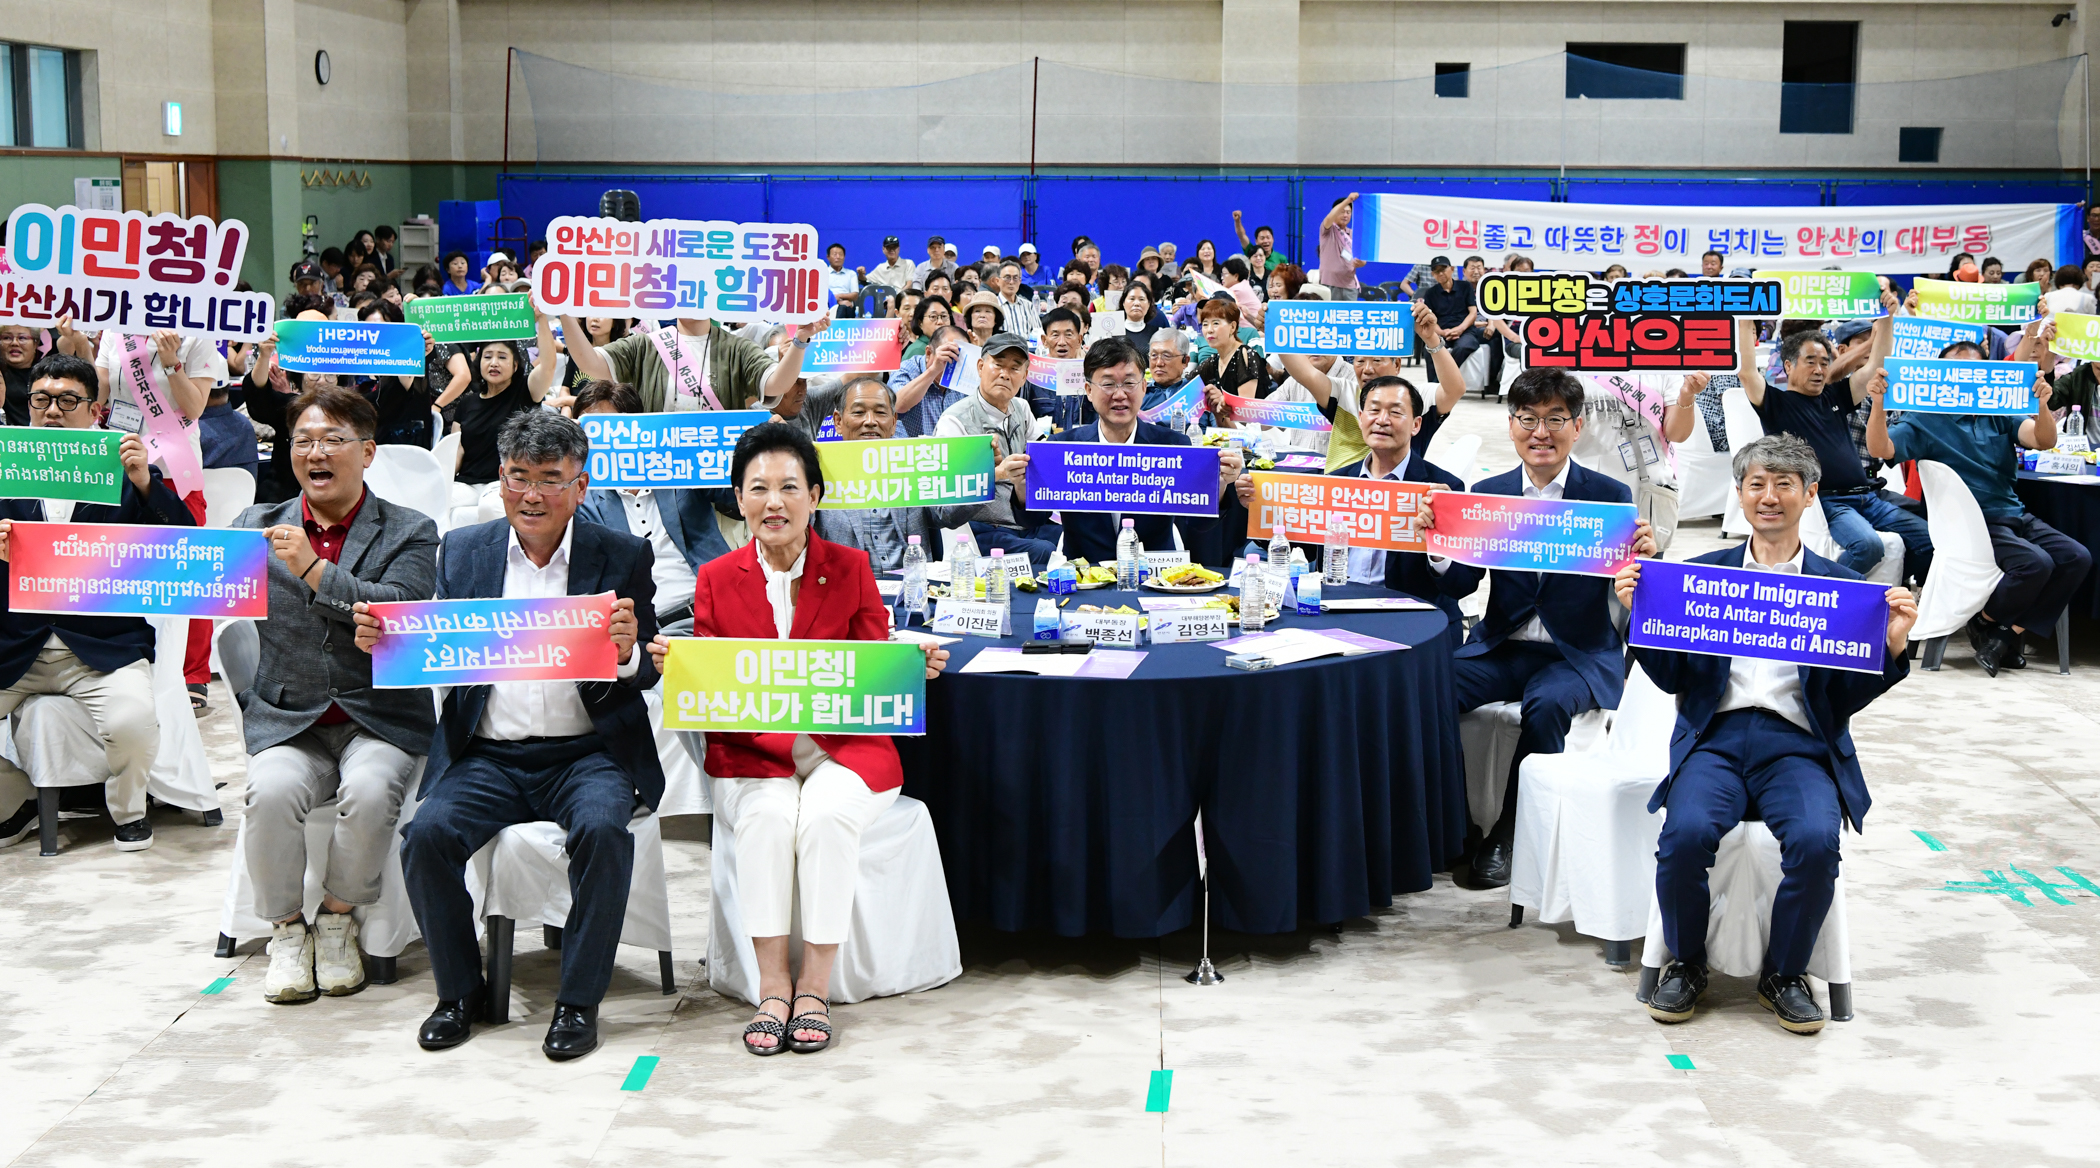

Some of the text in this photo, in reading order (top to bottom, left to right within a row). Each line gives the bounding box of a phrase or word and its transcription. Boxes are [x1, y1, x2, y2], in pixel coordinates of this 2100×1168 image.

[13, 211, 241, 286] 이민청!
[556, 225, 809, 261] 안산의 새로운 도전!
[1544, 225, 1625, 253] 따뜻한
[1634, 225, 1688, 255] 정이
[1708, 227, 1786, 256] 넘치는
[1797, 226, 1885, 257] 안산의
[1895, 224, 1991, 255] 대부동
[541, 260, 820, 315] 이민청과 함께!
[1485, 278, 1778, 313] 이민청은 상호문화도시
[1788, 275, 1850, 296] 이민청!
[1950, 285, 2008, 302] 이민청!
[0, 281, 267, 335] 안산시가 합니다!
[1279, 308, 1399, 325] 안산의 새로운 도전!
[1827, 298, 1881, 316] 합니다!
[1921, 302, 2036, 321] 안산시가 합니다!
[318, 327, 380, 345] Ансан!
[1274, 325, 1404, 350] 이민청과 함께!
[1527, 316, 1734, 369] 안산으로
[1893, 322, 1921, 338] 안산의
[1921, 325, 1952, 341] 새로운
[306, 344, 391, 357] Этим займётся город
[658, 331, 684, 361] 대부동
[2055, 337, 2100, 358] 안산시
[312, 355, 372, 366] миграционной
[373, 357, 422, 368] Управление
[129, 356, 164, 418] 주민자치회
[1900, 366, 2024, 385] 안산의 새로운 도전!
[1892, 383, 2029, 409] 이민청과 함께!
[584, 420, 657, 450] 안산의
[660, 426, 719, 448] 새로운
[591, 451, 694, 482] 이민청과
[862, 443, 949, 474] 이민청!
[1063, 450, 1183, 472] Kantor Imigrant
[823, 472, 989, 504] 안산시가 합니다!
[1066, 470, 1176, 488] Kota Antar Budaya
[1035, 487, 1209, 507] diharapkan berada di Ansan
[1261, 482, 1325, 506] 이민청!
[1331, 486, 1390, 512] 안산의
[1005, 564, 1031, 577] 영민
[1682, 574, 1839, 609] Kantor Imigrant
[381, 608, 605, 643] आप्रवासी कार्यालय
[957, 616, 999, 631] 이진분
[1095, 618, 1127, 626] 대부동장
[1181, 614, 1221, 622] 대부해양본부장
[1684, 600, 1828, 632] Kota Antar Budaya
[1085, 628, 1133, 643] 백종선
[1177, 622, 1225, 637] 김영식
[1642, 618, 1872, 659] diharapkan berada di Ansan
[421, 643, 571, 673] आन्सनशहर
[735, 648, 856, 689] 이민청!
[677, 691, 914, 726] 안산시가 합니다!
